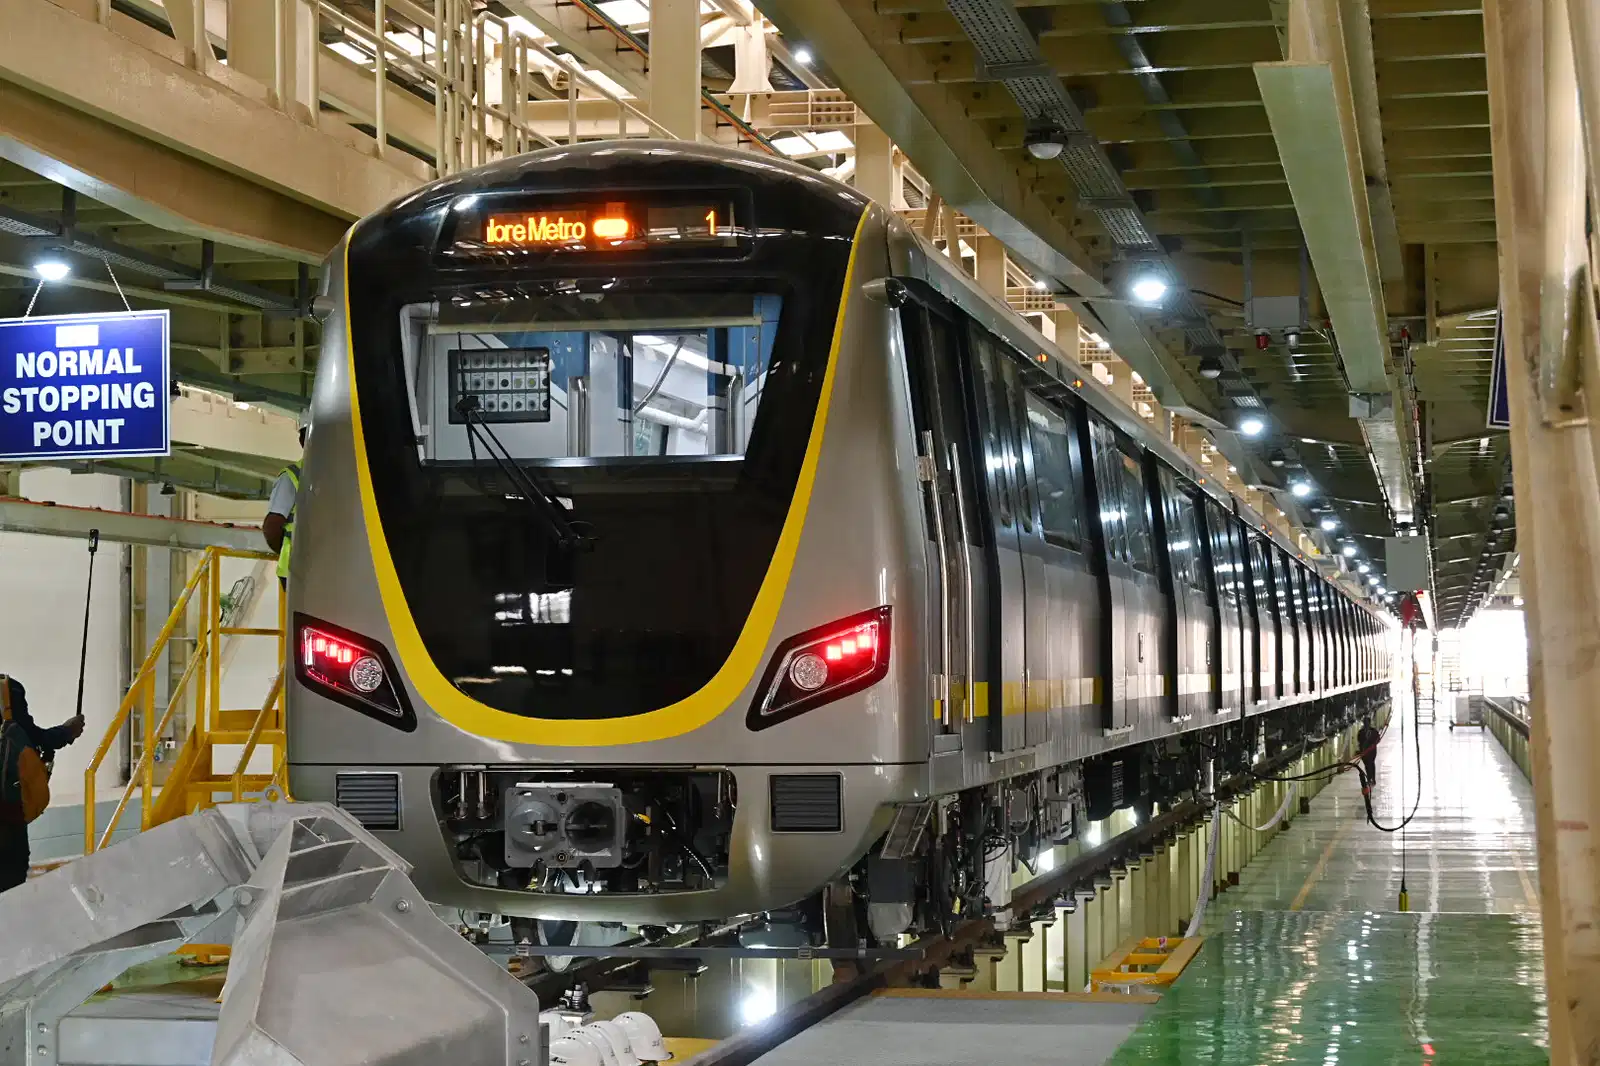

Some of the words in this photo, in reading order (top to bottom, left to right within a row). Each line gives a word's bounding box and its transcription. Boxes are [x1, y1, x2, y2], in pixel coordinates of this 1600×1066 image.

[528, 216, 586, 241] Metro
[705, 210, 715, 235] 1
[16, 348, 142, 378] NORMAL
[3, 382, 155, 414] STOPPING
[33, 418, 125, 447] POINT
